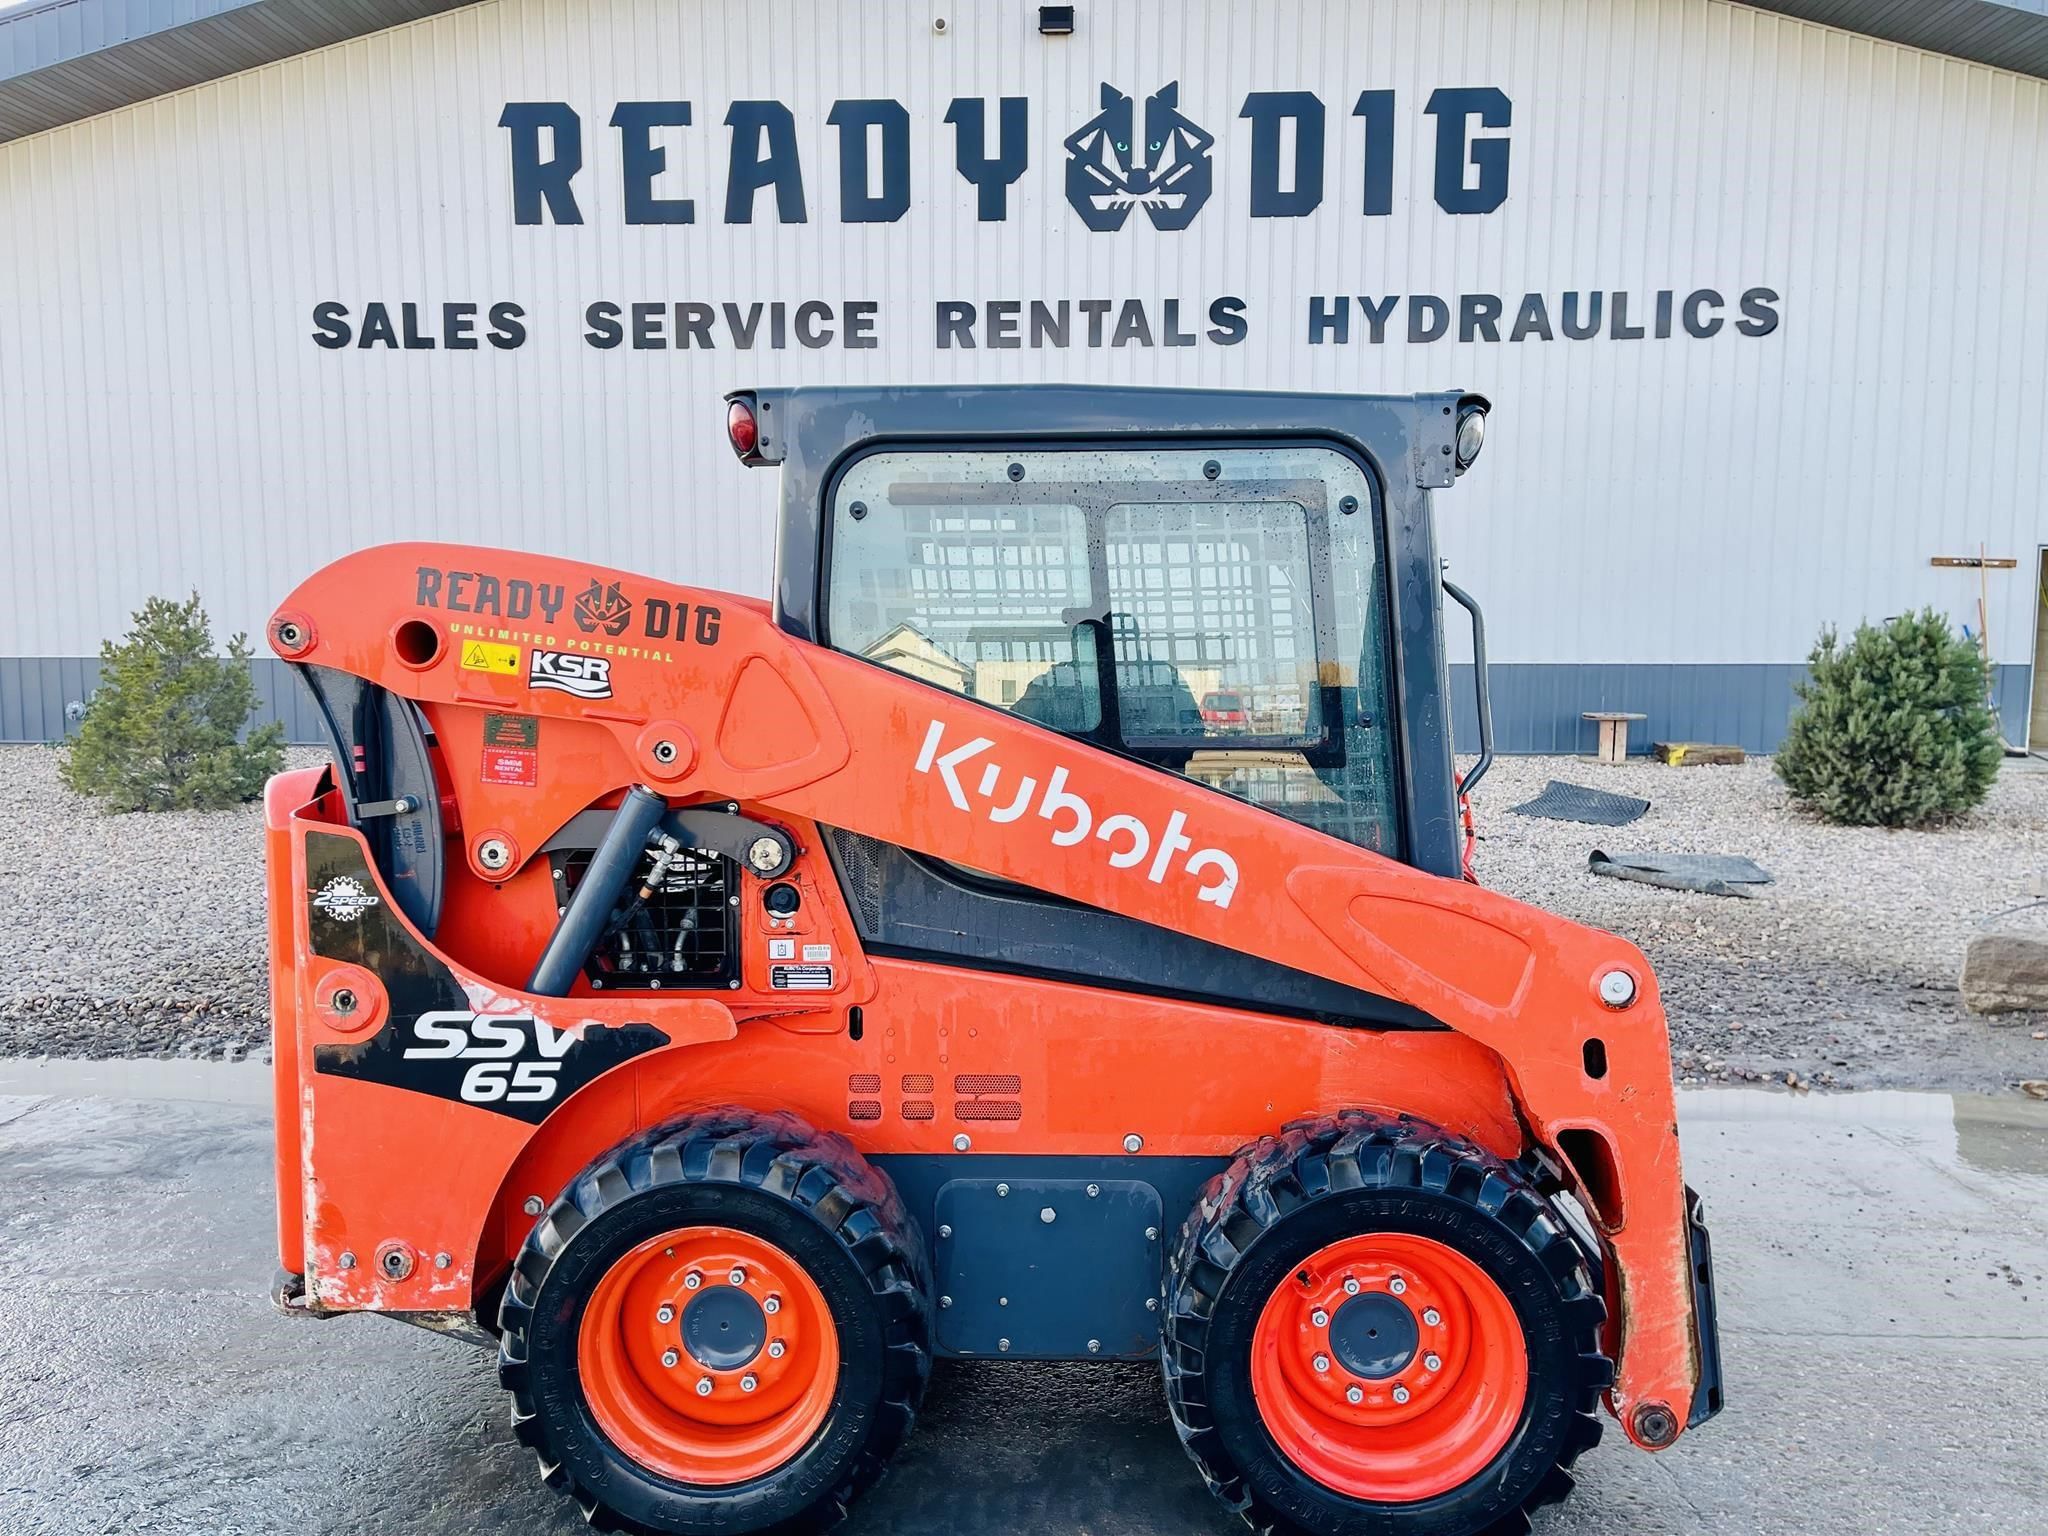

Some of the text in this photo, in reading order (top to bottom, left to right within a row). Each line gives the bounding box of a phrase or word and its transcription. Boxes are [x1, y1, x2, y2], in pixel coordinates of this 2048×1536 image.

[497, 97, 1028, 225] READY
[311, 287, 1780, 350] SALES SERVICE RENTALS HYDRAULICS
[416, 566, 564, 624] READY
[450, 622, 674, 663] UNLIMITED POTENTIAL
[531, 650, 611, 680] KSR
[914, 719, 1239, 910] Kubota
[403, 1010, 585, 1059] SSV
[460, 1062, 562, 1102] 65
